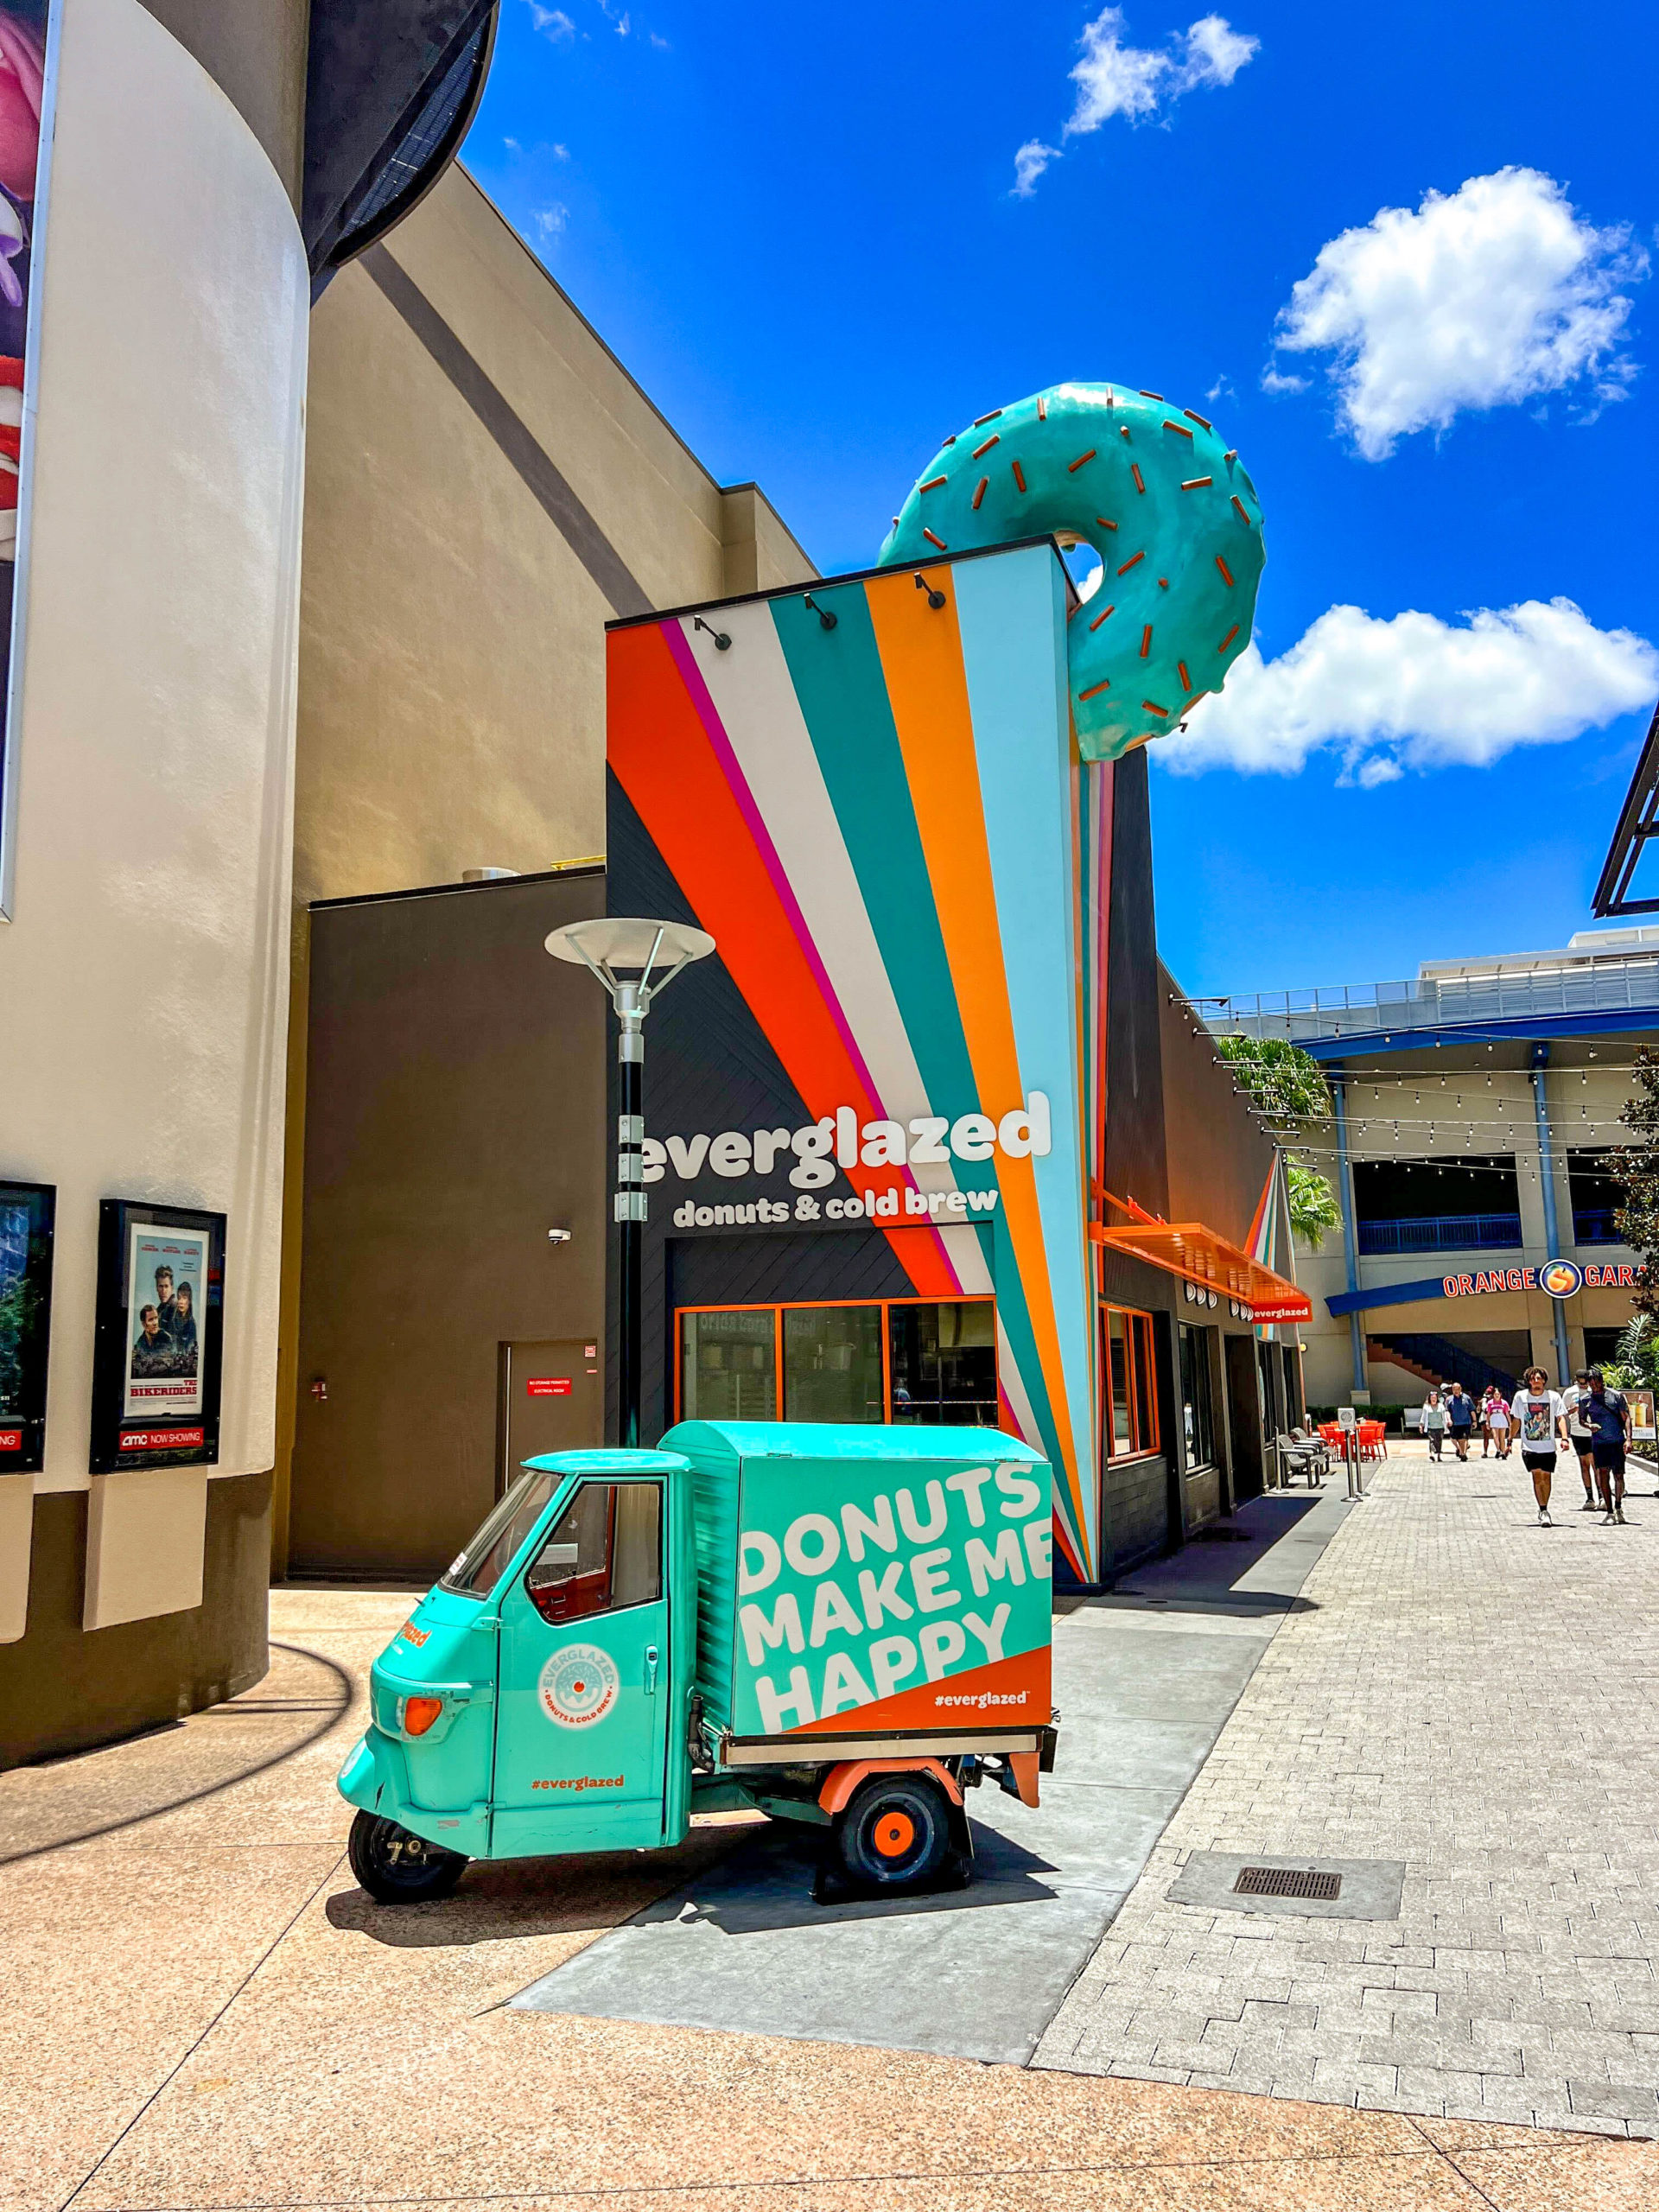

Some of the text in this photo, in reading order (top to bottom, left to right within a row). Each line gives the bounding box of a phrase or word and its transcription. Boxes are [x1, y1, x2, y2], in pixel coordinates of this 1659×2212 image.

[642, 1090, 1052, 1189] everglazed
[673, 1186, 999, 1228] donuts & cold brew
[1442, 1267, 1537, 1298] ORANGE
[1254, 1306, 1309, 1319] everglazed
[130, 1386, 198, 1397] BIKERIDERS
[150, 1433, 167, 1444] NOW
[168, 1432, 200, 1443] SHOWING
[739, 1463, 1041, 1597] DONUTS
[739, 1516, 1052, 1668] MAKE ME
[543, 1649, 614, 1688] EVERGLAZED
[754, 1602, 1012, 1735] HAPPY
[544, 1694, 569, 1721] DONUTS
[575, 1712, 597, 1723] COLD
[531, 1774, 624, 1791] #everglazed
